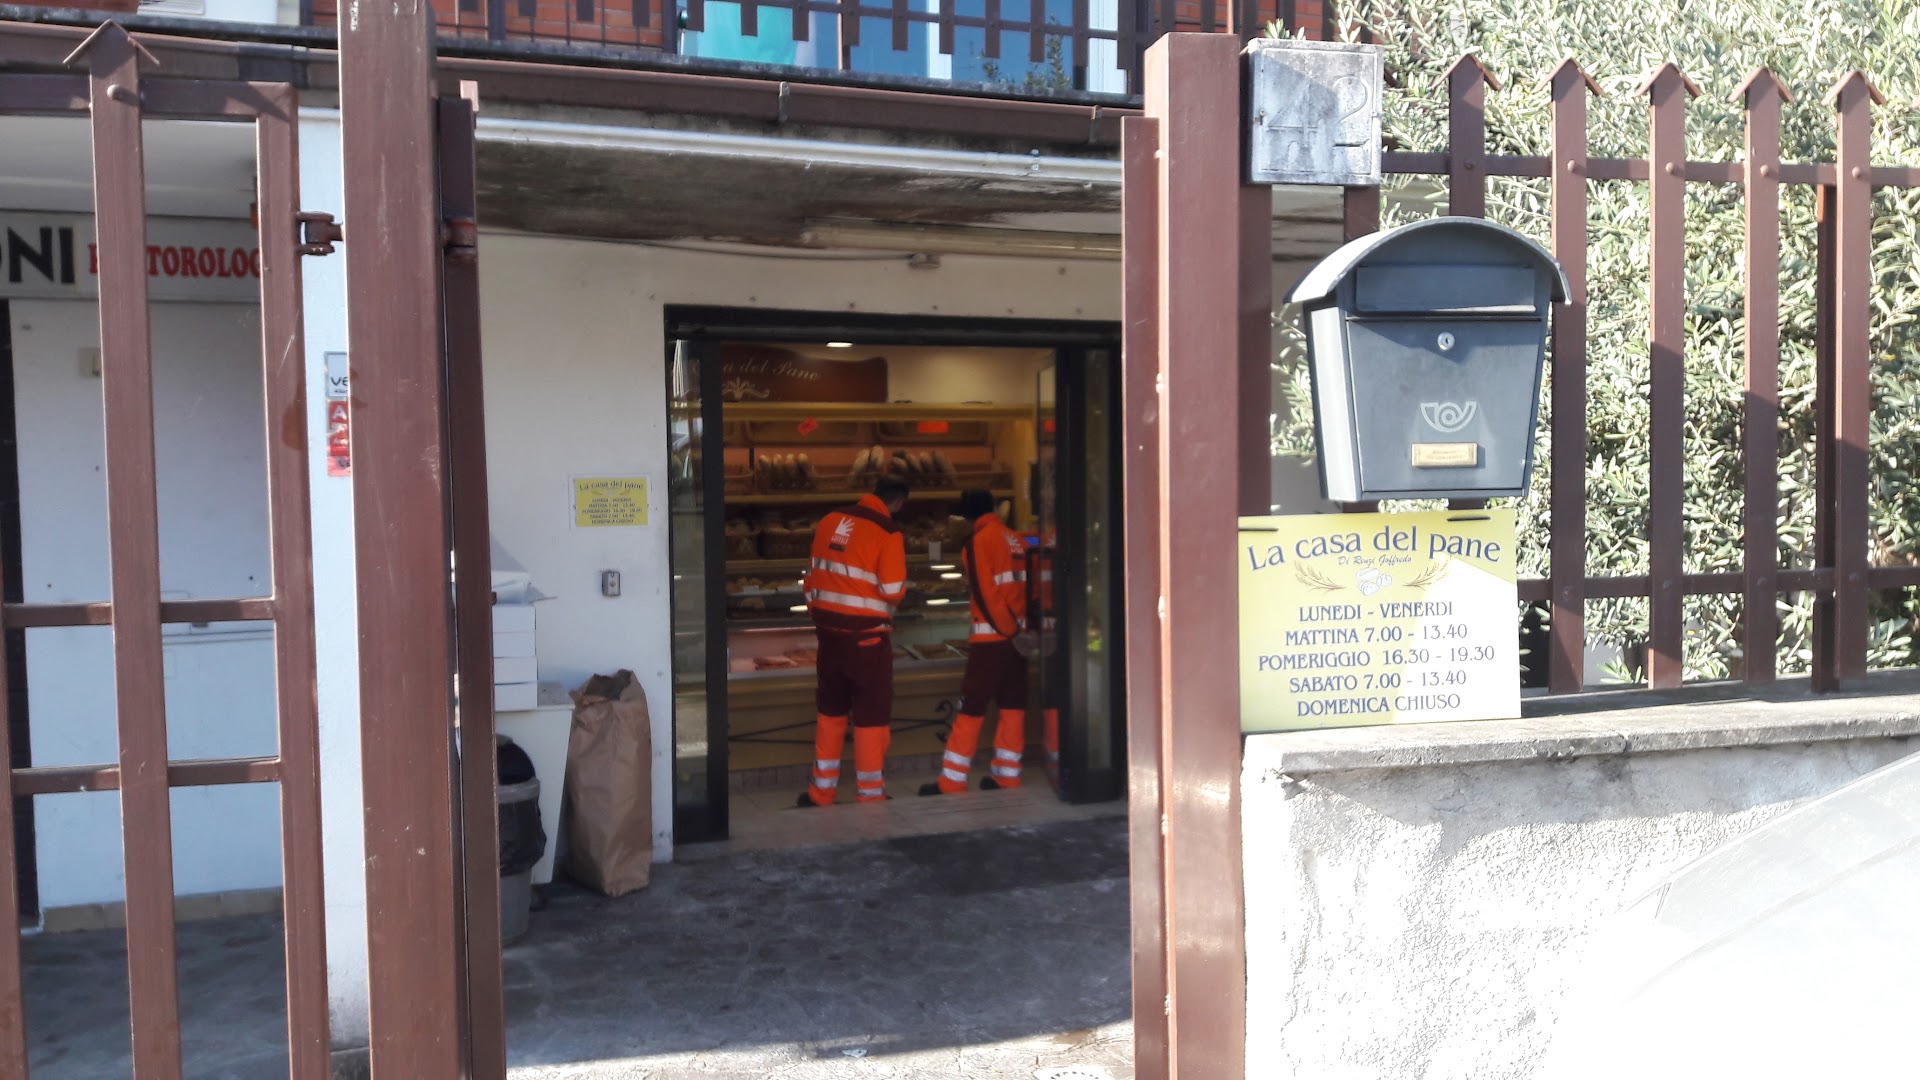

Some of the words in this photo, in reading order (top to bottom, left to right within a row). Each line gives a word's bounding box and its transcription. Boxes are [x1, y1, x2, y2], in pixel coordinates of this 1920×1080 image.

[0, 226, 75, 284] NI
[739, 358, 769, 374] del
[1248, 544, 1285, 571] La
[1295, 532, 1361, 559] casa
[1373, 525, 1417, 551] del
[1429, 533, 1501, 562] pane
[1337, 556, 1349, 566] Di
[1299, 605, 1362, 622] LUNEDI
[1379, 601, 1453, 619] VENERDI
[1285, 628, 1360, 646] MATTINA
[1364, 626, 1402, 643] 7.00
[1422, 623, 1468, 641] 13.40
[1258, 651, 1371, 671] POMERIGGIO
[1382, 649, 1430, 666] 16.30
[1450, 645, 1495, 662] 19.30
[1289, 675, 1358, 693] SABATO
[1363, 673, 1401, 690] 7.00
[1422, 670, 1467, 686] 13.40
[1297, 697, 1390, 717] DOMENICA
[1394, 693, 1461, 711] CHIUSO
